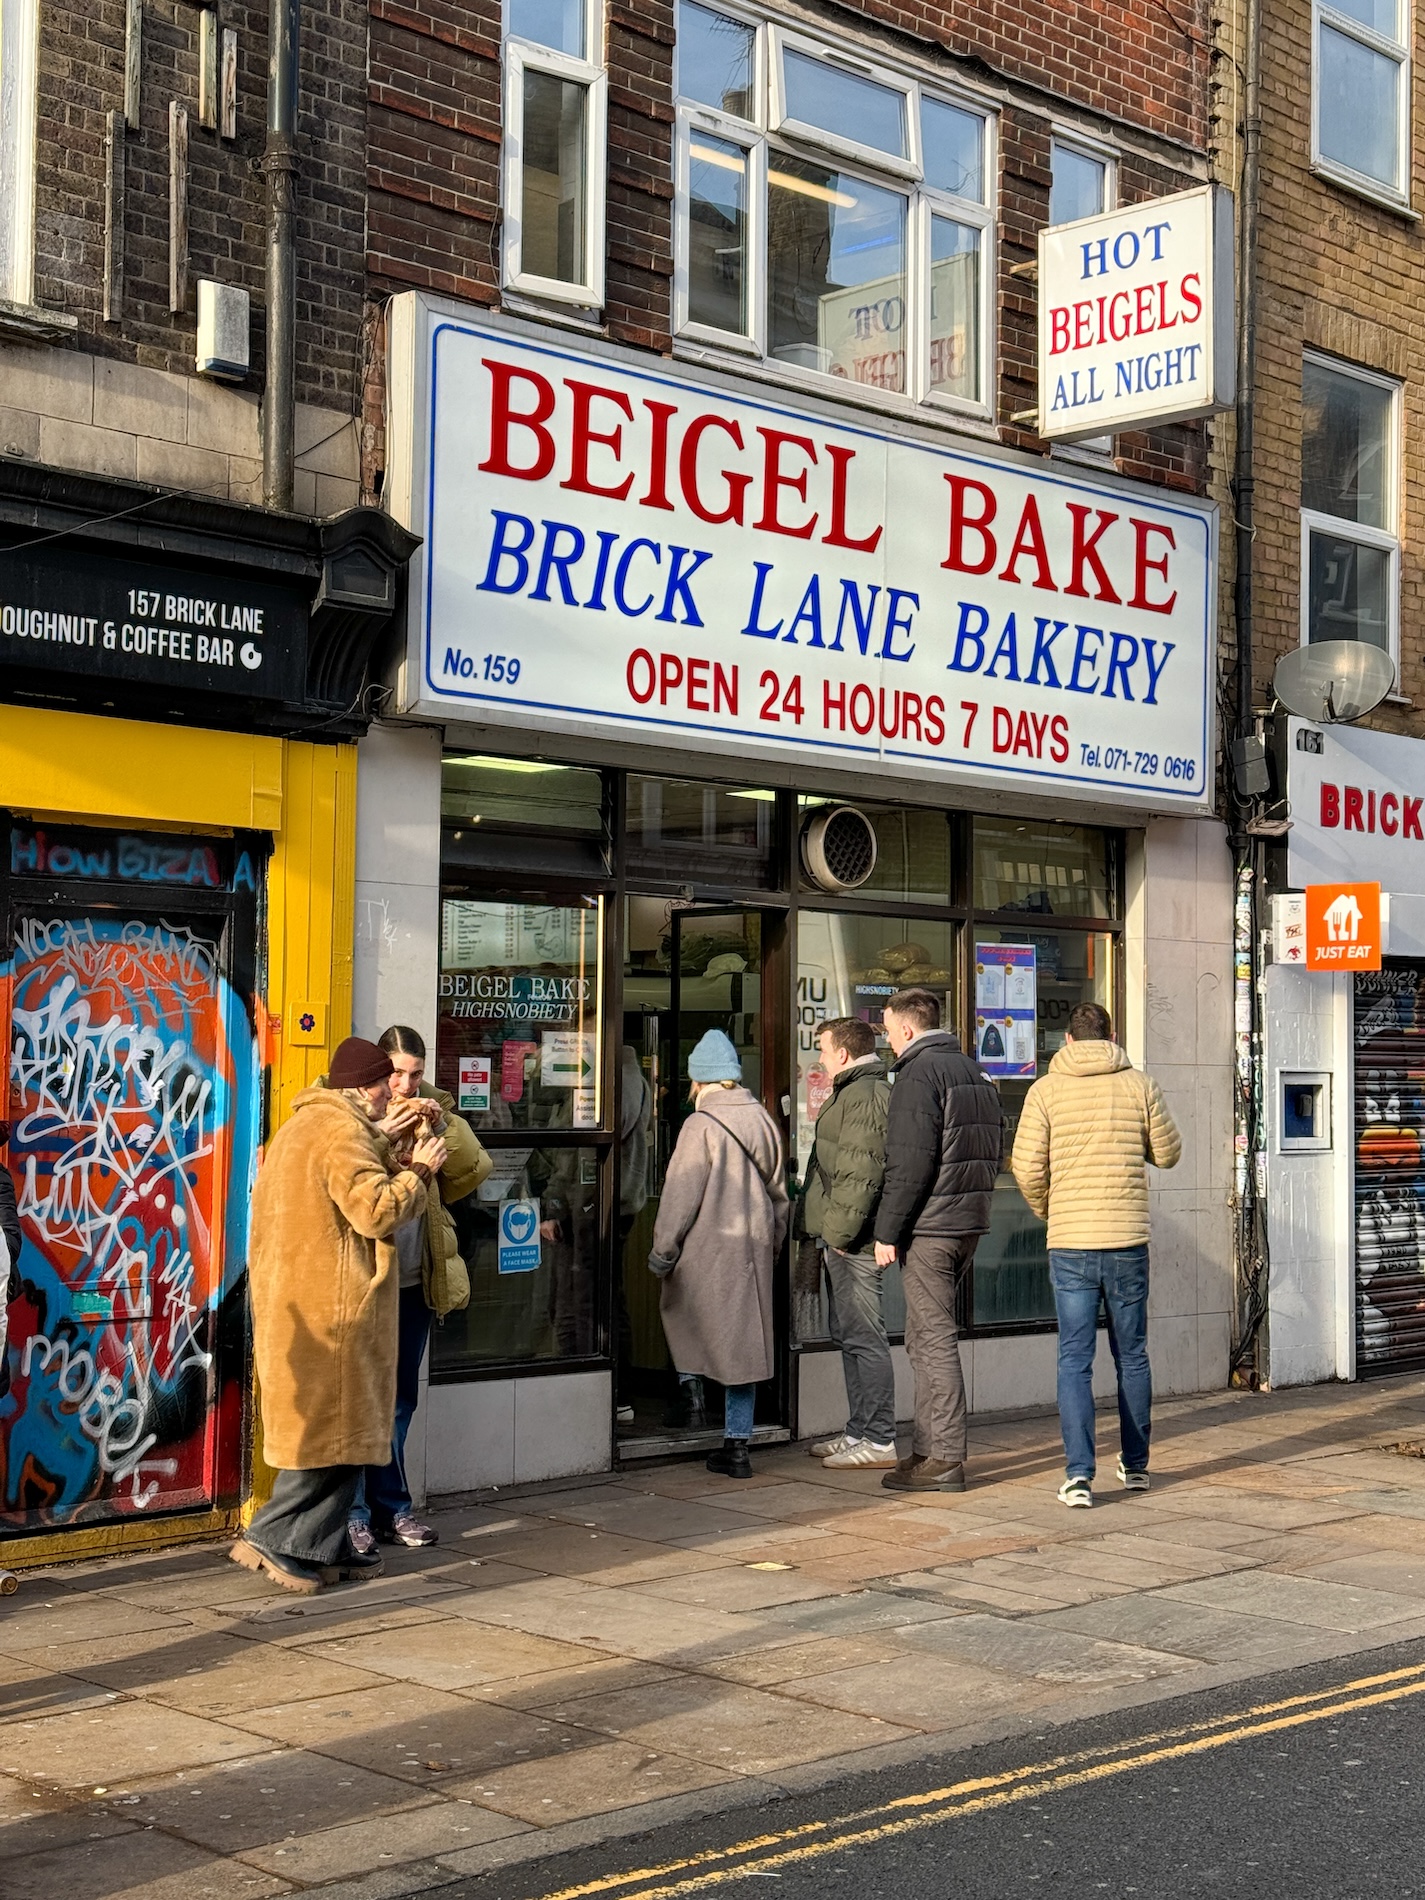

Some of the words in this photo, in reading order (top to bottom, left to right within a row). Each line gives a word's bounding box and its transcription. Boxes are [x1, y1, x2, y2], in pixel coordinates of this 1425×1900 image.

[1080, 221, 1172, 280] HOT
[1049, 272, 1203, 356] BEIGELS
[1050, 367, 1104, 411] ALL
[1114, 343, 1202, 398] NIGHT
[478, 358, 884, 553] BEIGEL
[940, 473, 1178, 615] BAKE
[0, 605, 98, 647] OUGHNUT
[102, 620, 117, 650] &
[121, 623, 193, 661] COFFEE
[196, 634, 235, 667] BAR
[128, 588, 161, 618] 157
[164, 594, 217, 628] BRICK
[220, 602, 265, 635] LANE
[476, 509, 713, 627] BRICK
[740, 561, 921, 663] LANE
[946, 601, 1176, 705] BAKERY
[626, 647, 739, 716] OPEN
[759, 669, 805, 725] 24
[822, 679, 946, 746] HOURS
[961, 701, 979, 749] 7
[992, 706, 1069, 763] DAYS
[1164, 755, 1196, 781] 0616
[1297, 728, 1324, 754] 161
[1320, 781, 1425, 841] BRICK
[1315, 946, 1346, 961] JUST
[1347, 945, 1372, 959] EAT
[438, 974, 521, 998] BEIGEL
[530, 977, 591, 1001] BAKE
[451, 1001, 579, 1020] HIGHSNOBIETY
[855, 984, 900, 996] HIGHSNOBIETY
